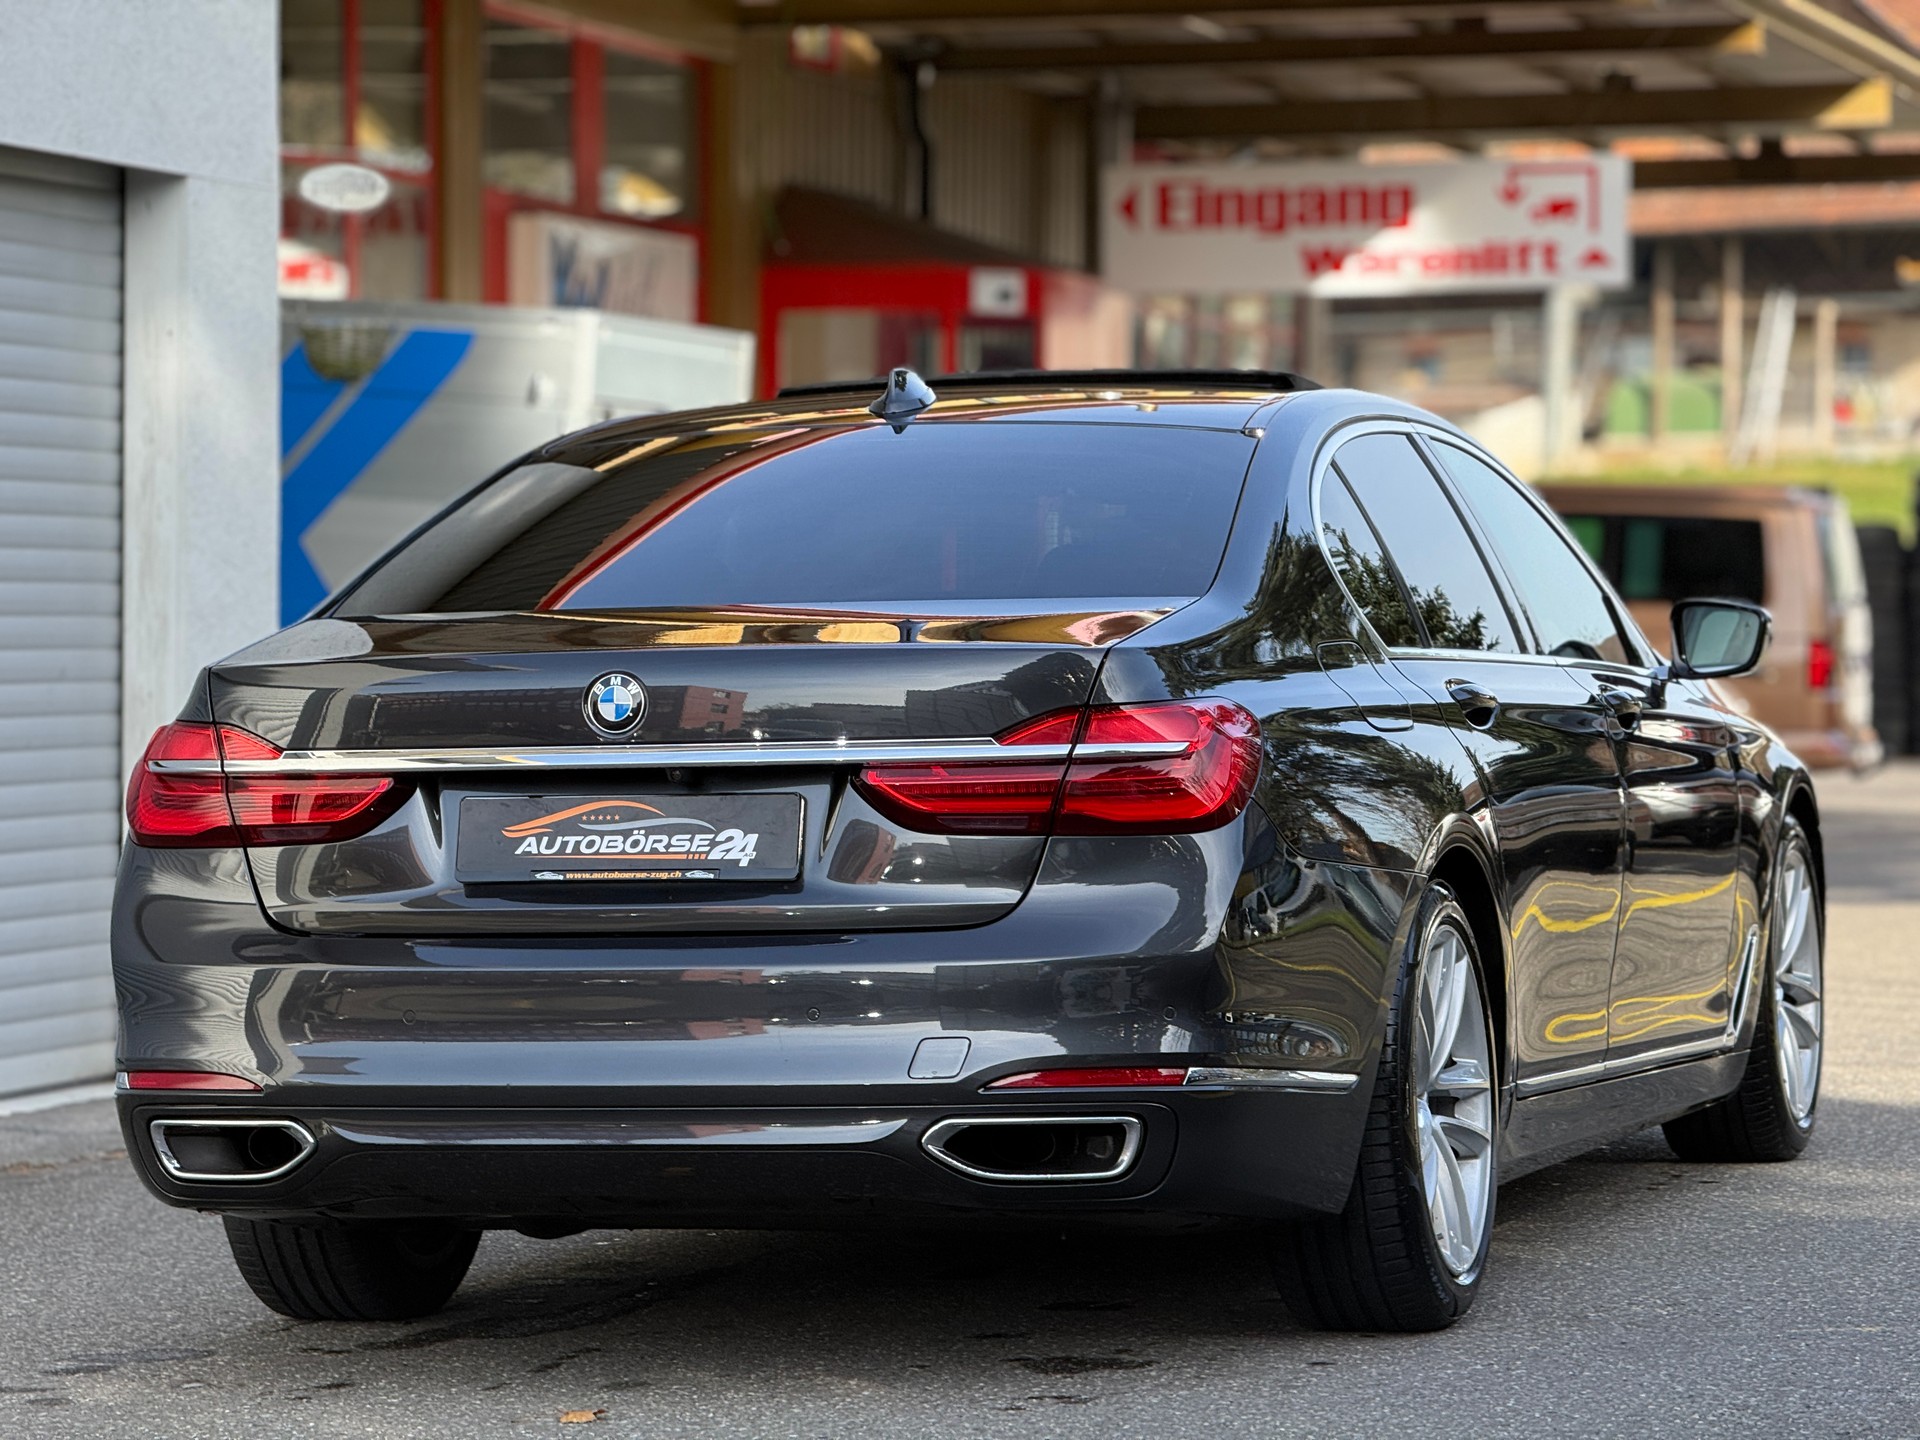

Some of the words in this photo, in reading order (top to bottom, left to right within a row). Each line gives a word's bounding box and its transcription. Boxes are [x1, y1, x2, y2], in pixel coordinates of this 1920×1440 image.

[1154, 180, 1415, 235] Eingang
[593, 676, 641, 696] BMW
[565, 871, 682, 880] www.autoboerse-zug.ch
